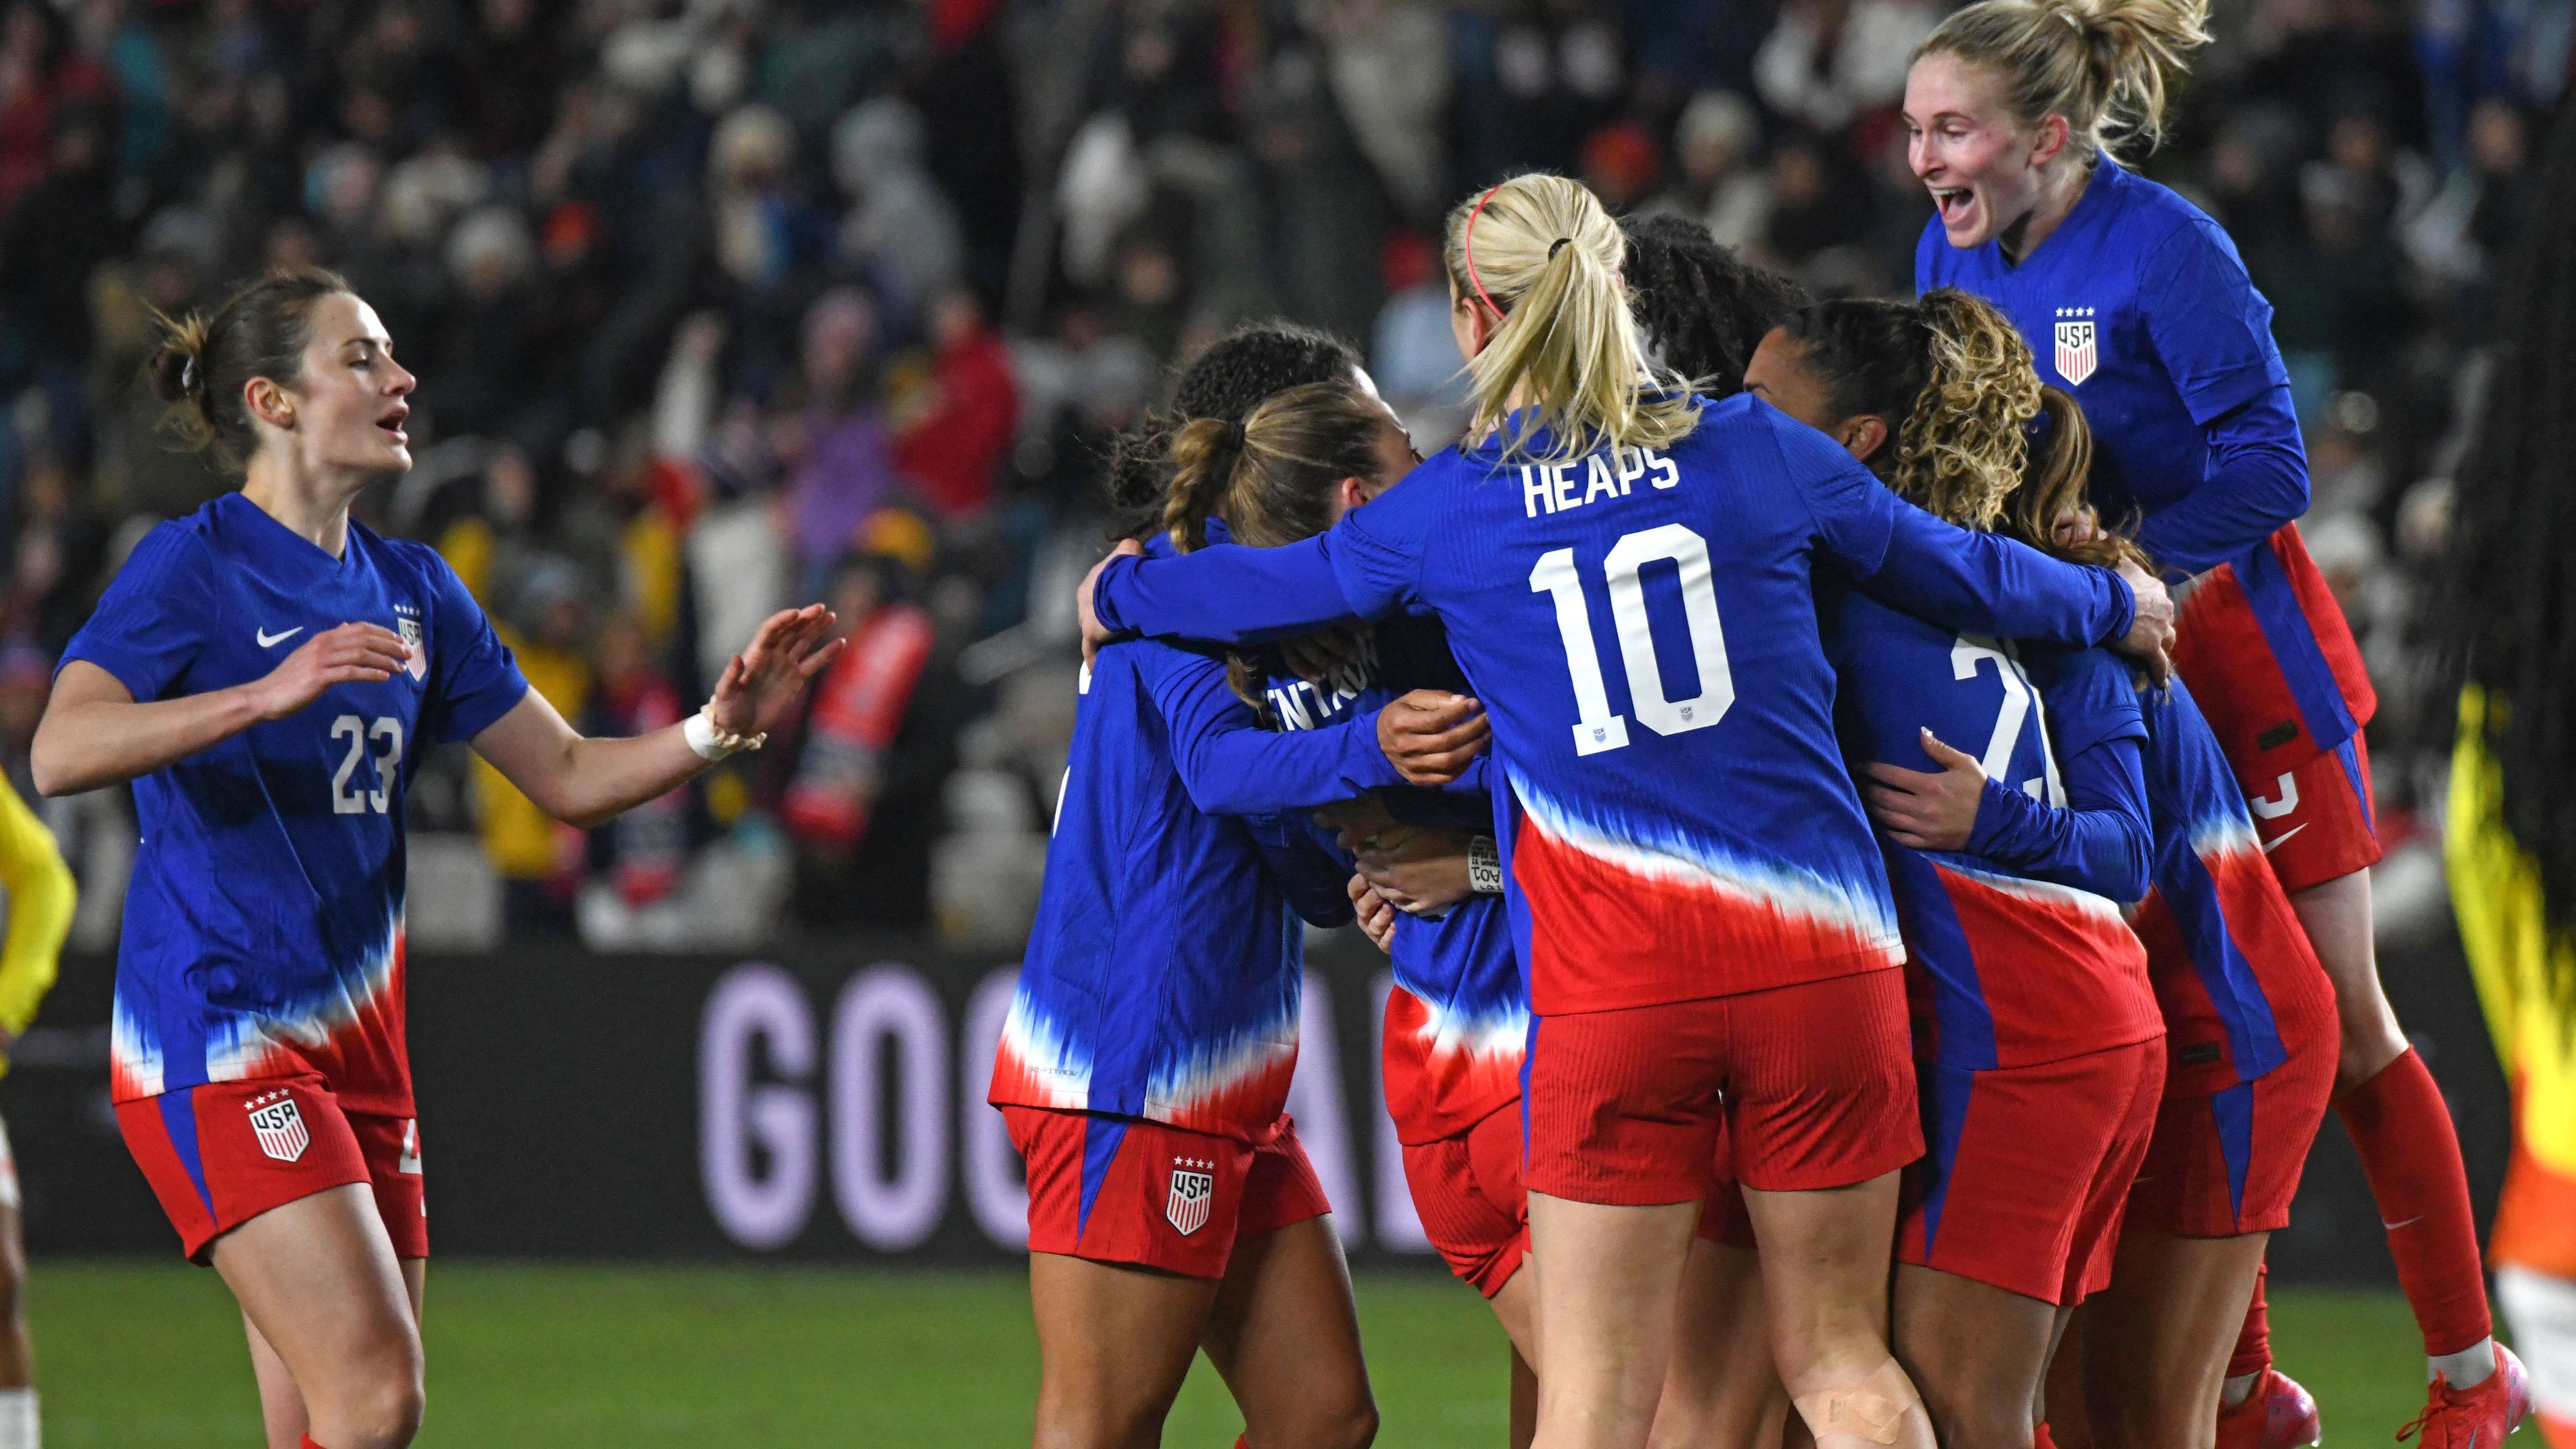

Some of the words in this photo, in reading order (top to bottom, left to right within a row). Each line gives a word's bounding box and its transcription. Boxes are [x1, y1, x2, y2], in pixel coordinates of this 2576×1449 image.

[2058, 325, 2092, 349] USA
[1521, 445, 1680, 518] HEAPS
[399, 621, 421, 645] USA
[1528, 523, 1735, 757] 10
[331, 715, 402, 814] 23
[253, 1103, 295, 1129] USA
[1174, 1174, 1210, 1199] USA
